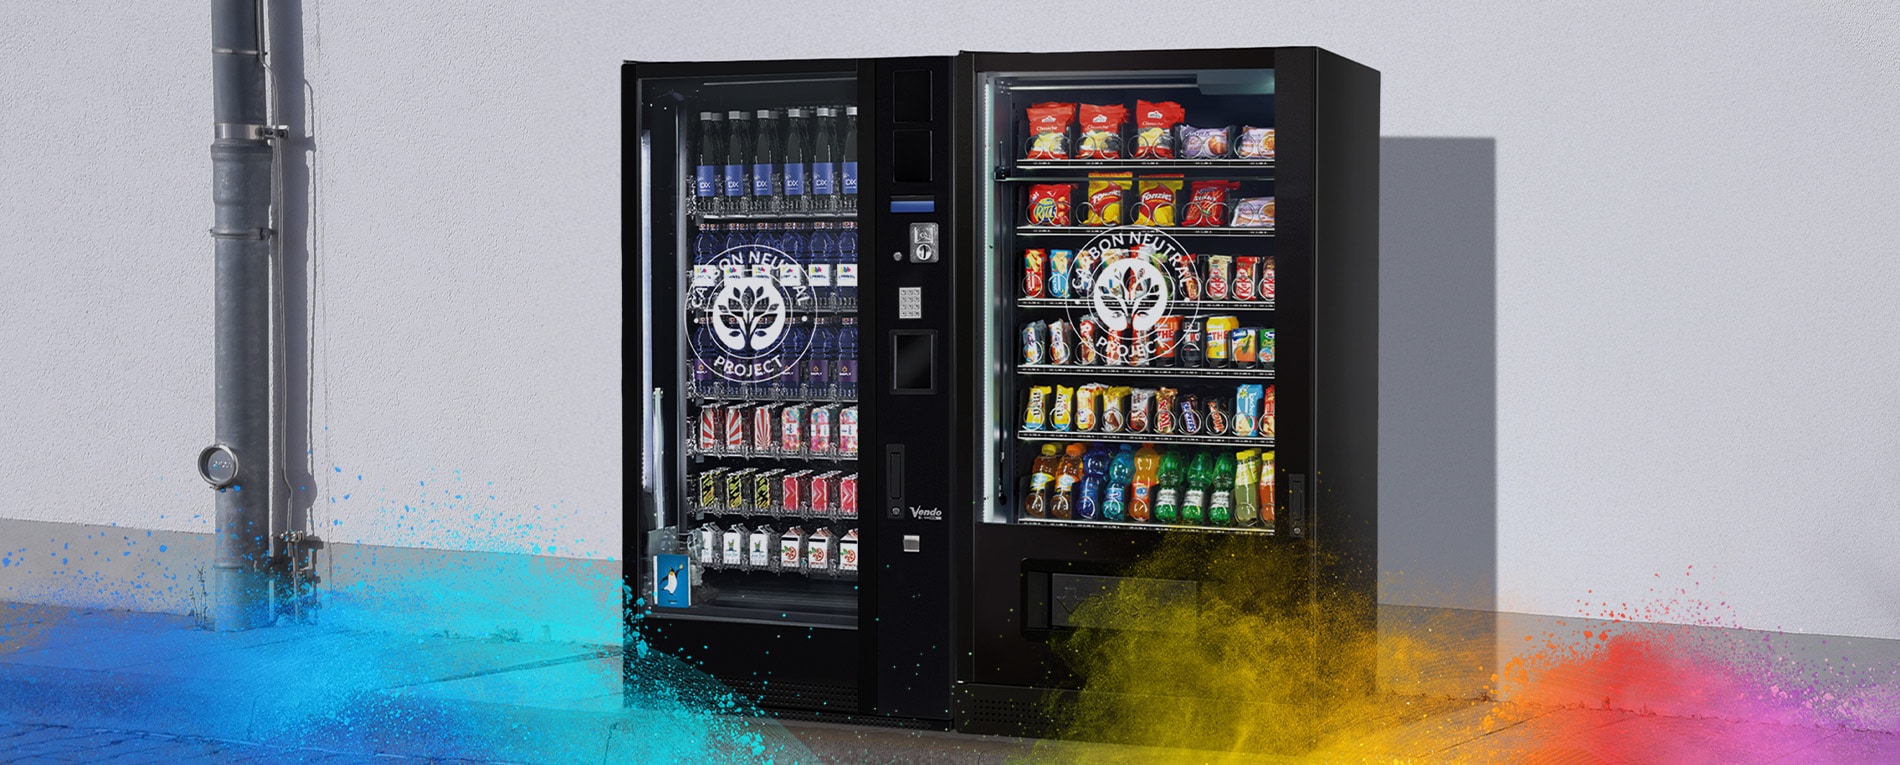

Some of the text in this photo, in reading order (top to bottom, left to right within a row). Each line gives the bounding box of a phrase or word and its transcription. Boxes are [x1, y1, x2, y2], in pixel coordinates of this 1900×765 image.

[1072, 231, 1193, 289] CABON NEUTRAL
[691, 251, 811, 307] CABON NEUAL
[713, 354, 783, 377] PROJECT
[1158, 400, 1171, 430] TWX
[909, 505, 942, 518] Vendo
